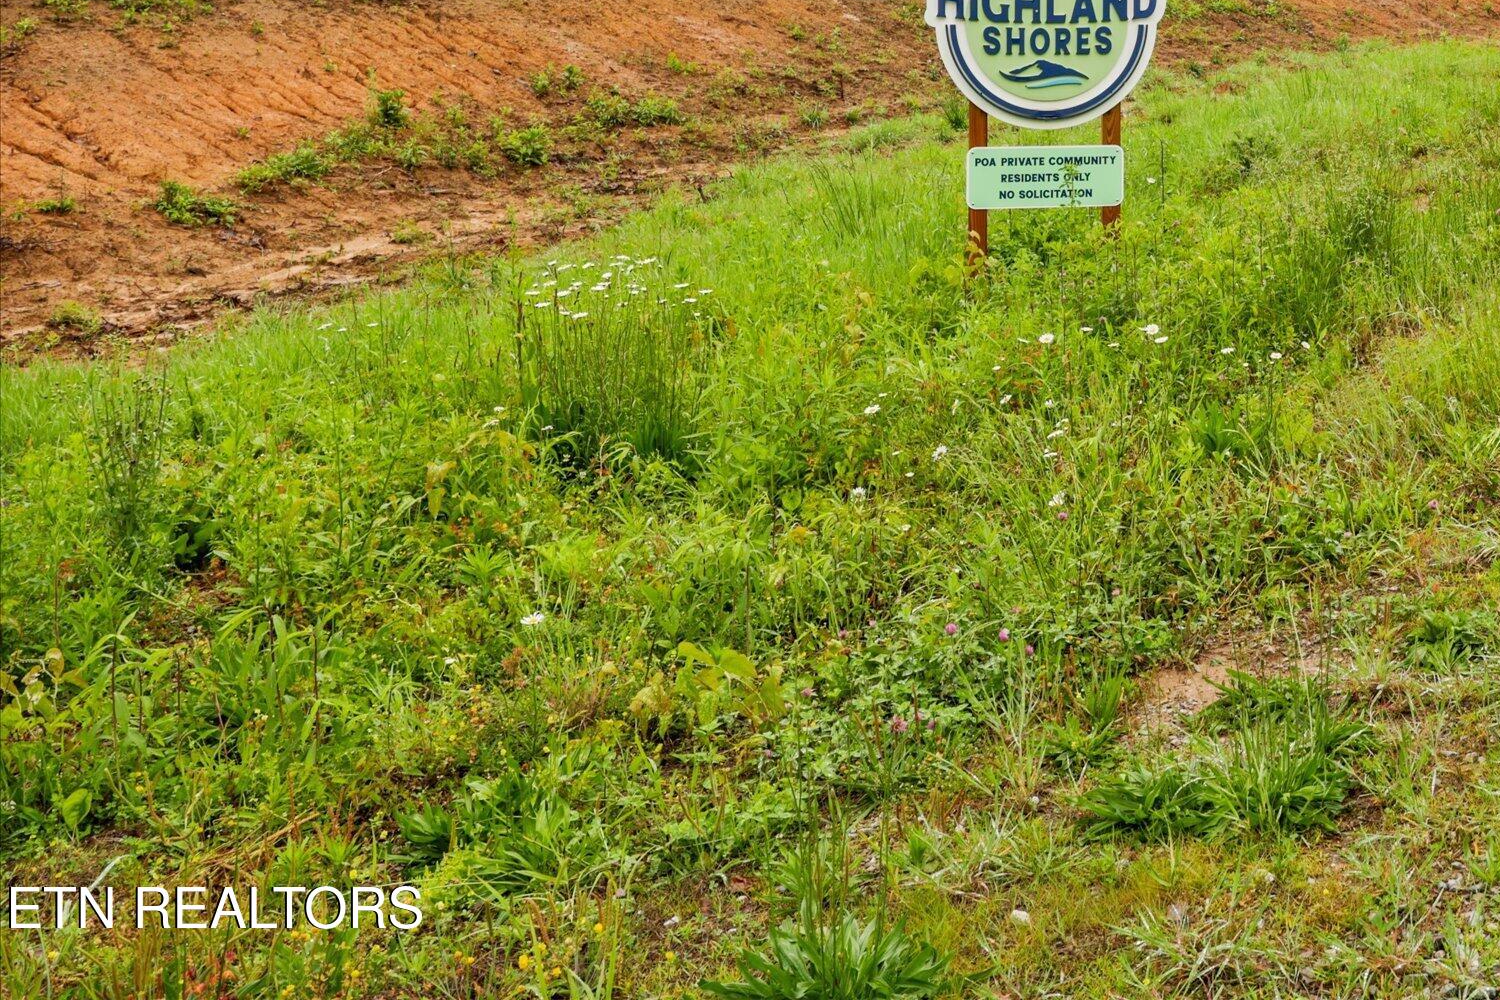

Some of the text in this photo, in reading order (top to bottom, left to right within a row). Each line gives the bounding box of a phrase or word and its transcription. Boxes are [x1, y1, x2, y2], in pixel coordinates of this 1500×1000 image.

[982, 26, 1113, 56] SHORES
[974, 156, 1116, 167] POA PRIVATE COMMUNITY
[1000, 173, 1060, 183] RESIDENTS
[999, 190, 1015, 200] NO
